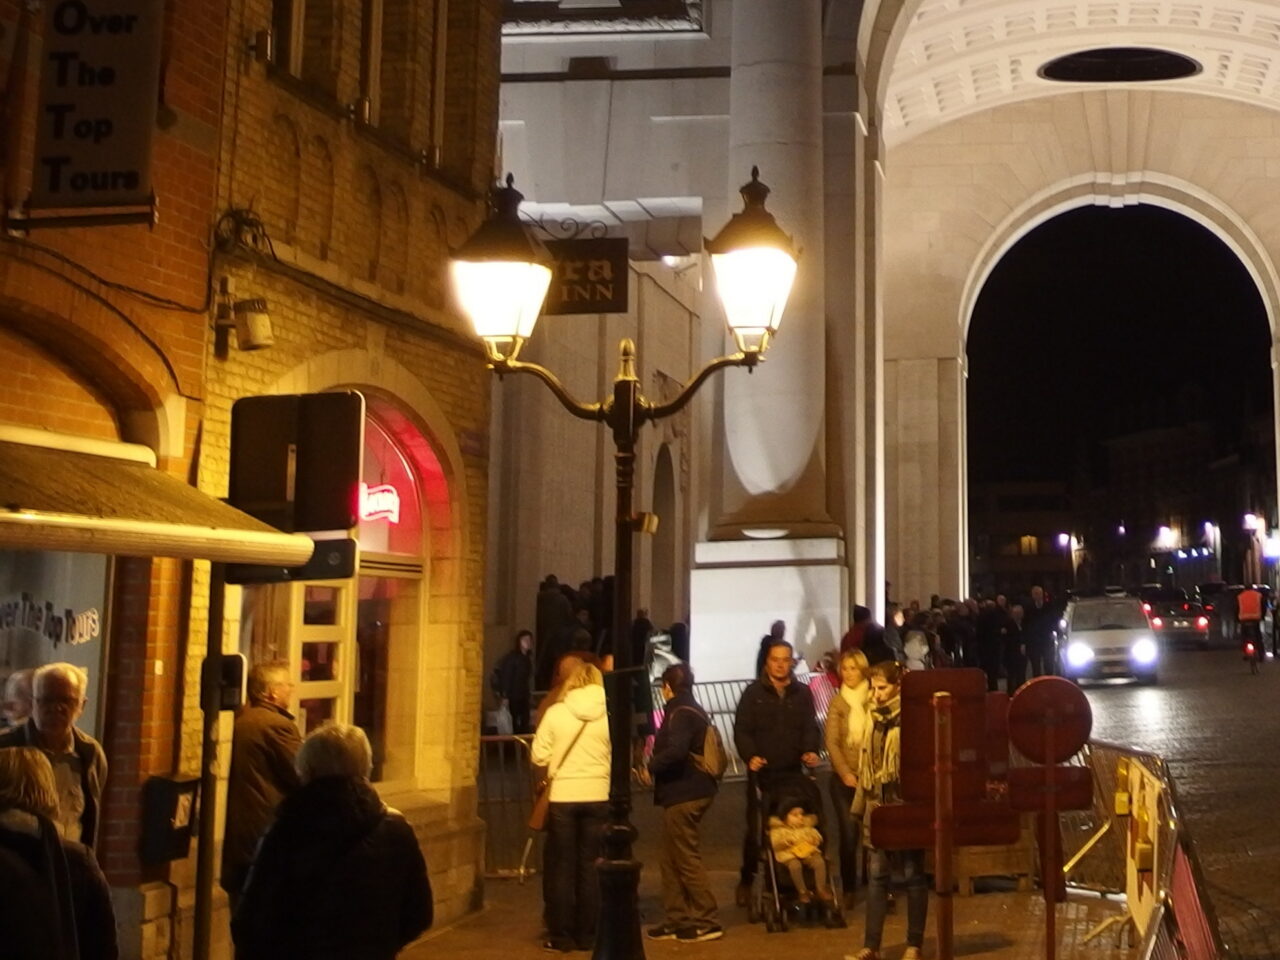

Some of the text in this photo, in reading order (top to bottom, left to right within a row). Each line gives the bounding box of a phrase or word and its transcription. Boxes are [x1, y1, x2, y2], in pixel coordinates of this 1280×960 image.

[53, 0, 139, 35] Over
[50, 51, 116, 87] The
[46, 103, 113, 144] Top
[41, 156, 140, 193] Tours
[560, 283, 614, 301] INN
